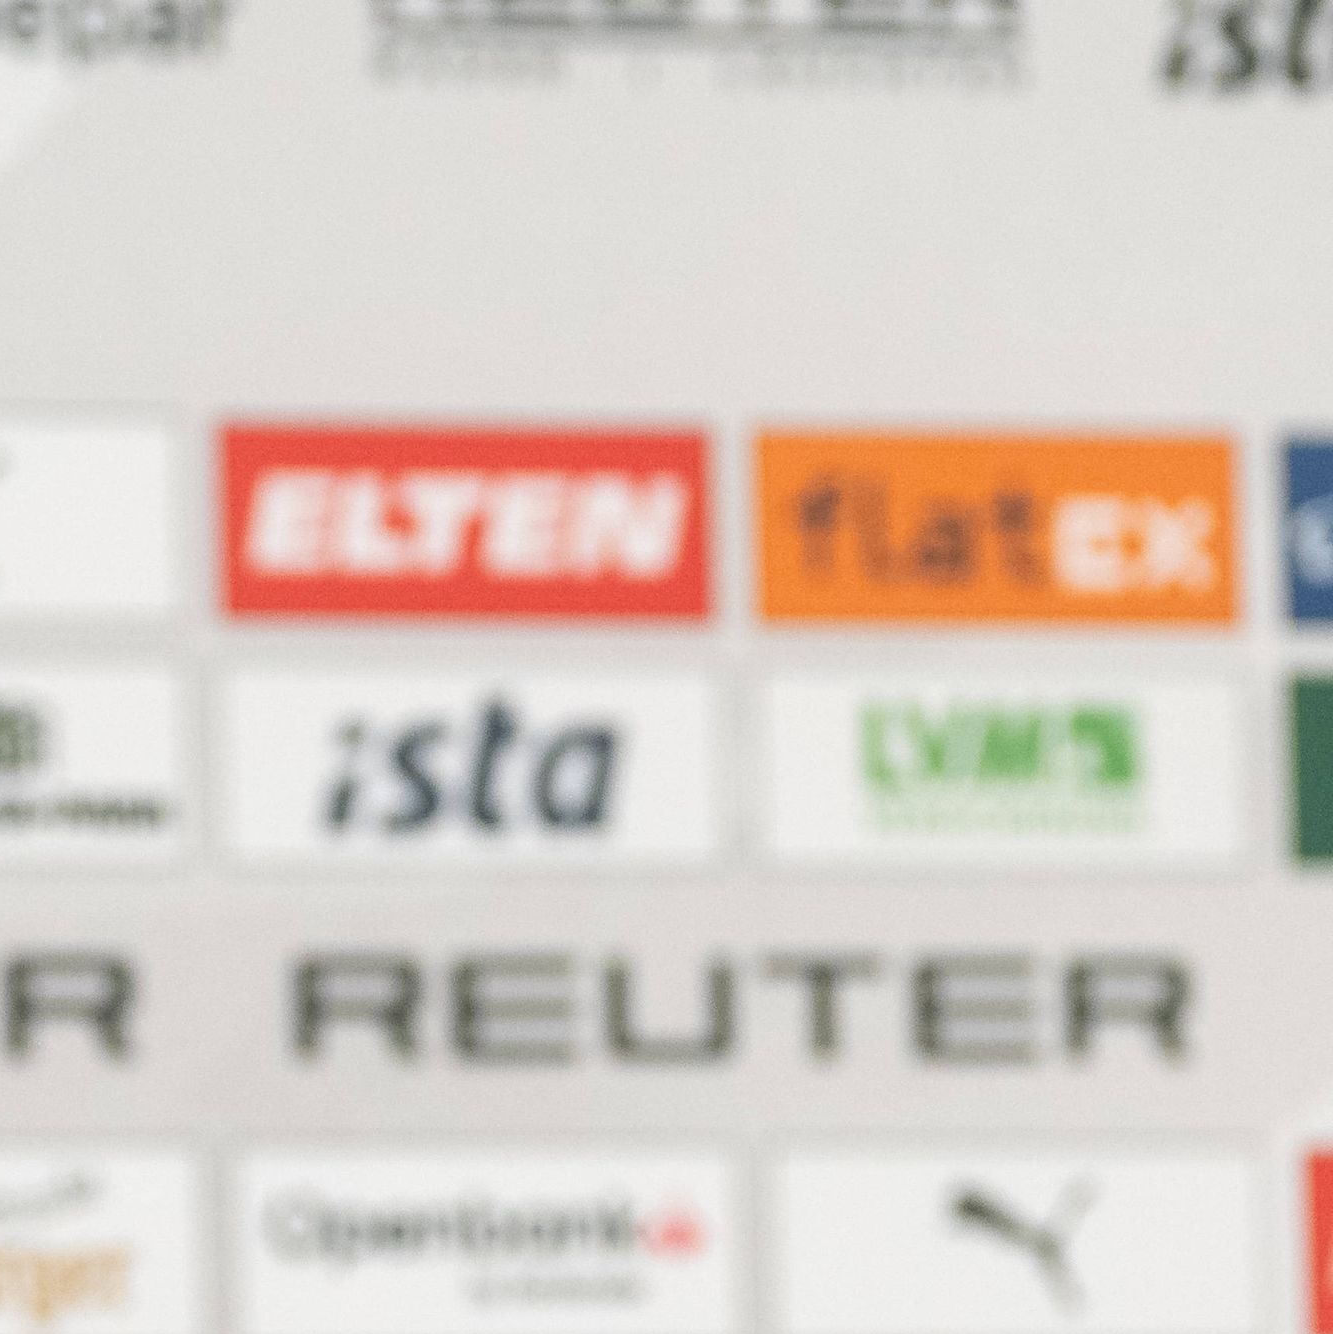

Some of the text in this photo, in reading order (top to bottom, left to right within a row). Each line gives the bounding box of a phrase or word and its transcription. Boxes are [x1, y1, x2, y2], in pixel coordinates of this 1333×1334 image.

[243, 465, 691, 582] ELTEN
[318, 688, 623, 836] ista
[288, 945, 1199, 1068] REUTER
